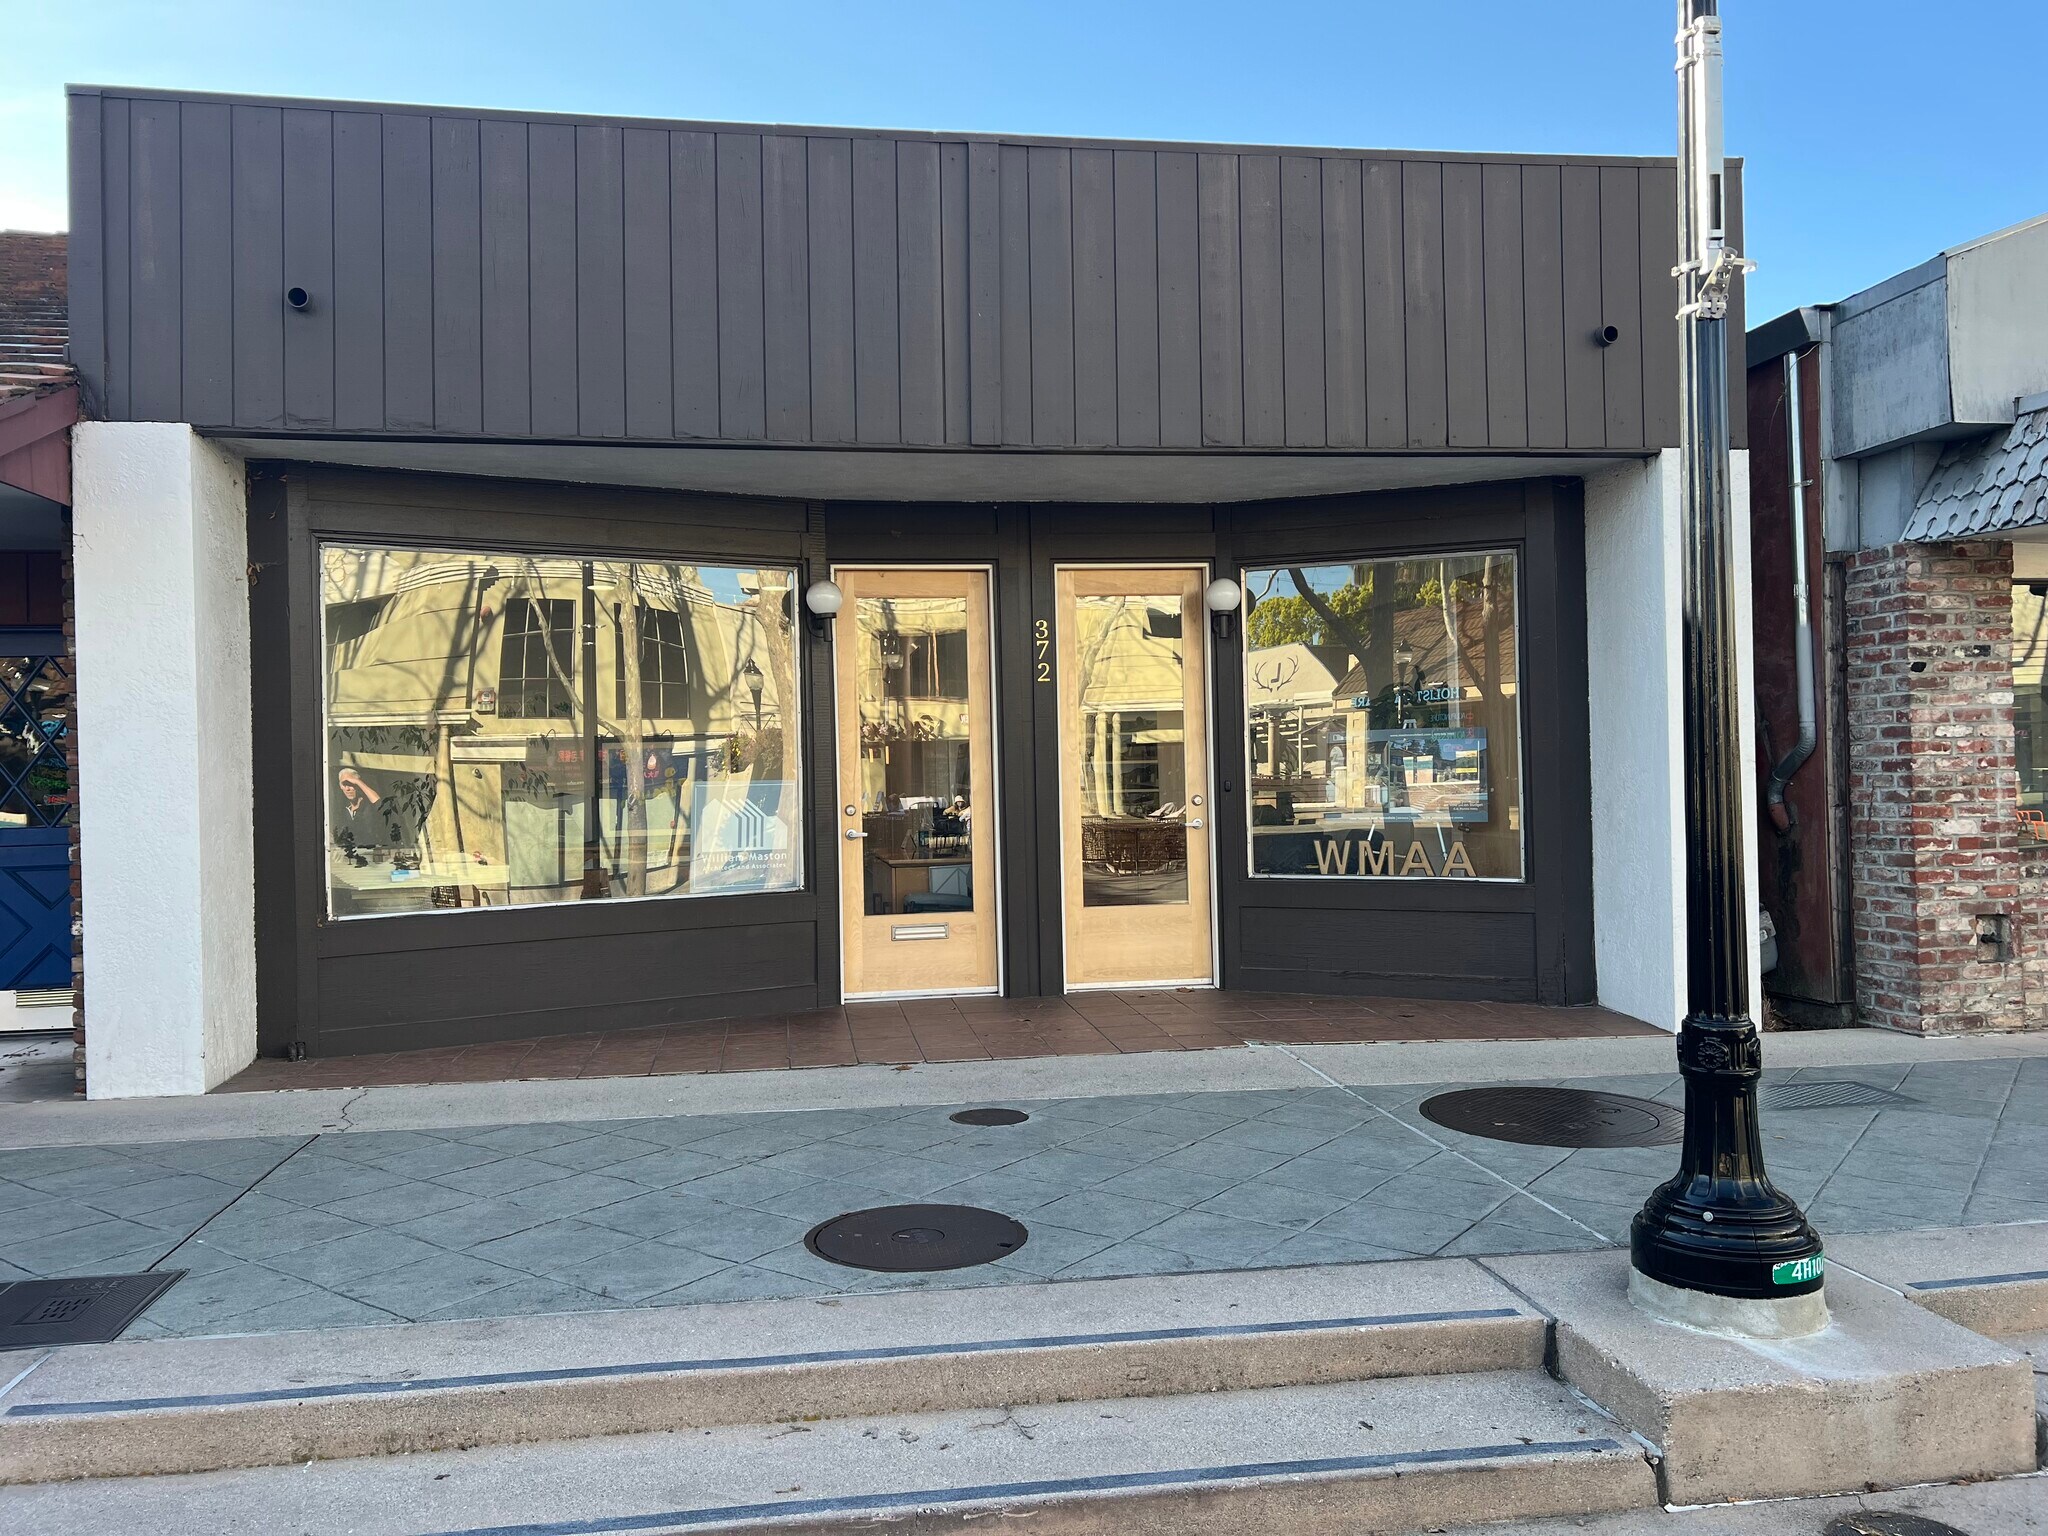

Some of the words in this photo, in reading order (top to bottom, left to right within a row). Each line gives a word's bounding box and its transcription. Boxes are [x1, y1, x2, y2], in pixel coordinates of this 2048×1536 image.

[1035, 619, 1051, 682] 372
[702, 854, 744, 863] William
[748, 852, 787, 862] Maston
[751, 862, 786, 870] Associates
[1313, 839, 1477, 877] WMAA
